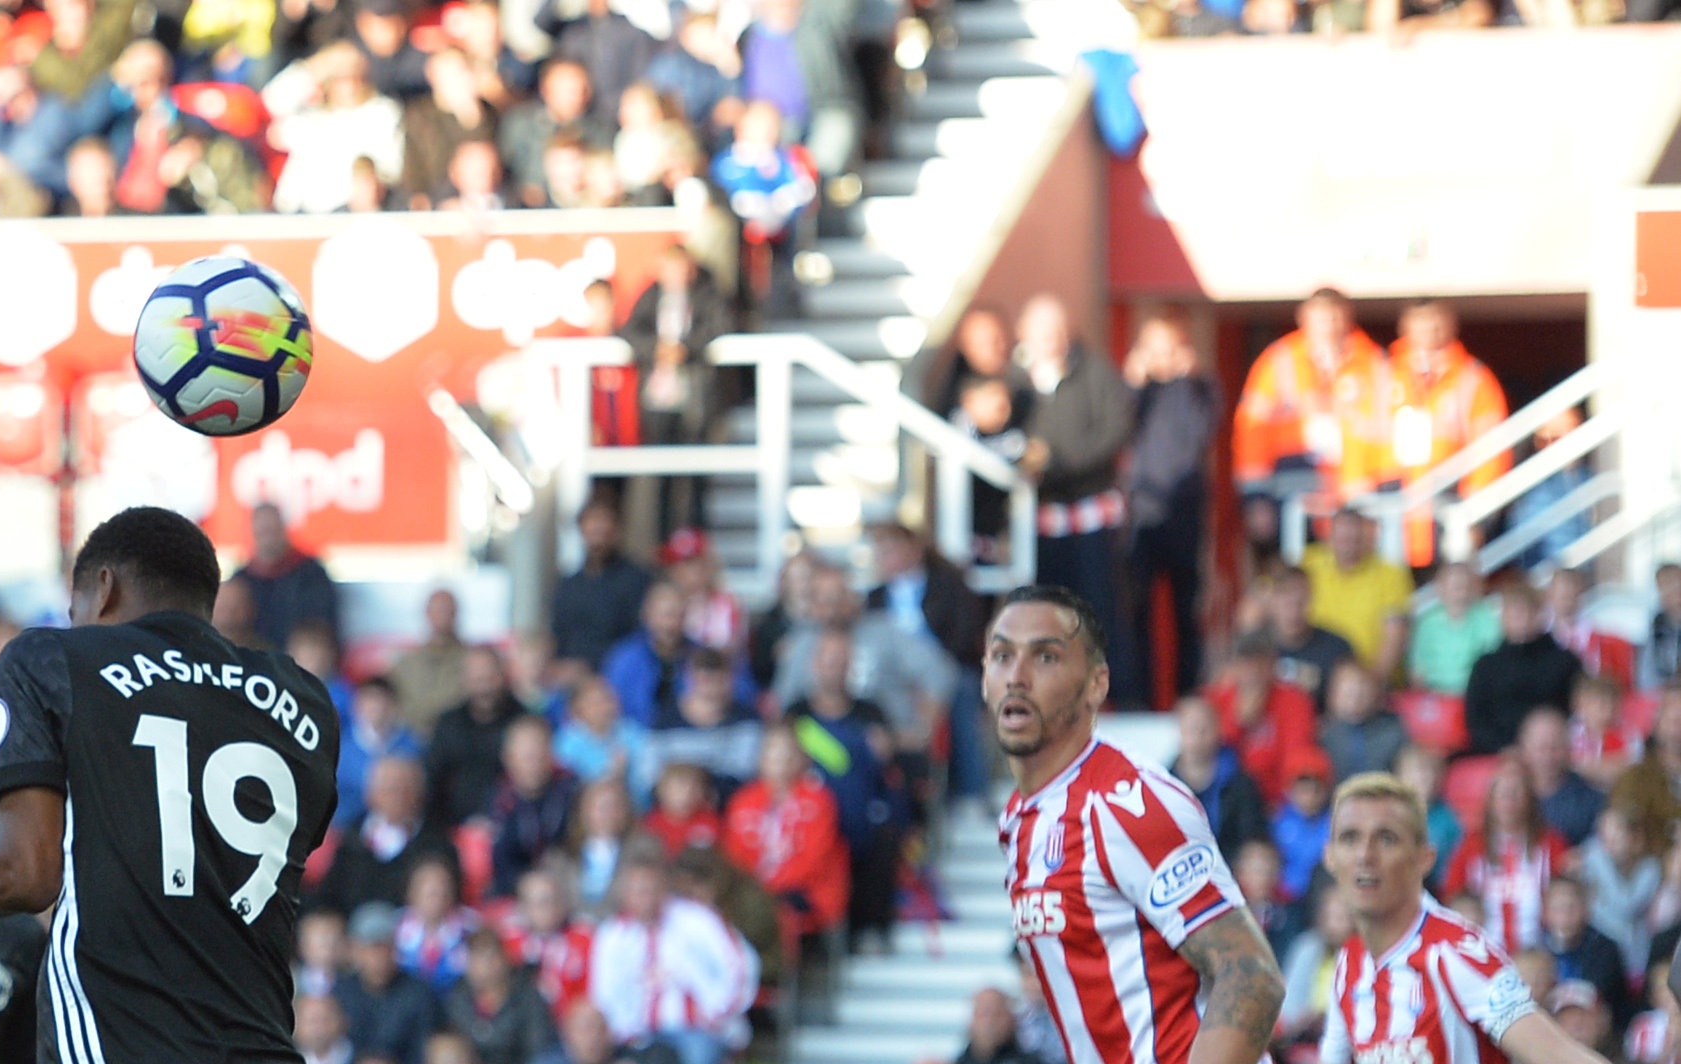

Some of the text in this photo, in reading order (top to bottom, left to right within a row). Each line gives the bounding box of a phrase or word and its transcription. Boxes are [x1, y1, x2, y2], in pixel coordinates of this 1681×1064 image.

[231, 427, 385, 528] dpd
[99, 649, 320, 751] RASHFORD
[131, 713, 298, 926] 19
[1155, 851, 1204, 888] TOP
